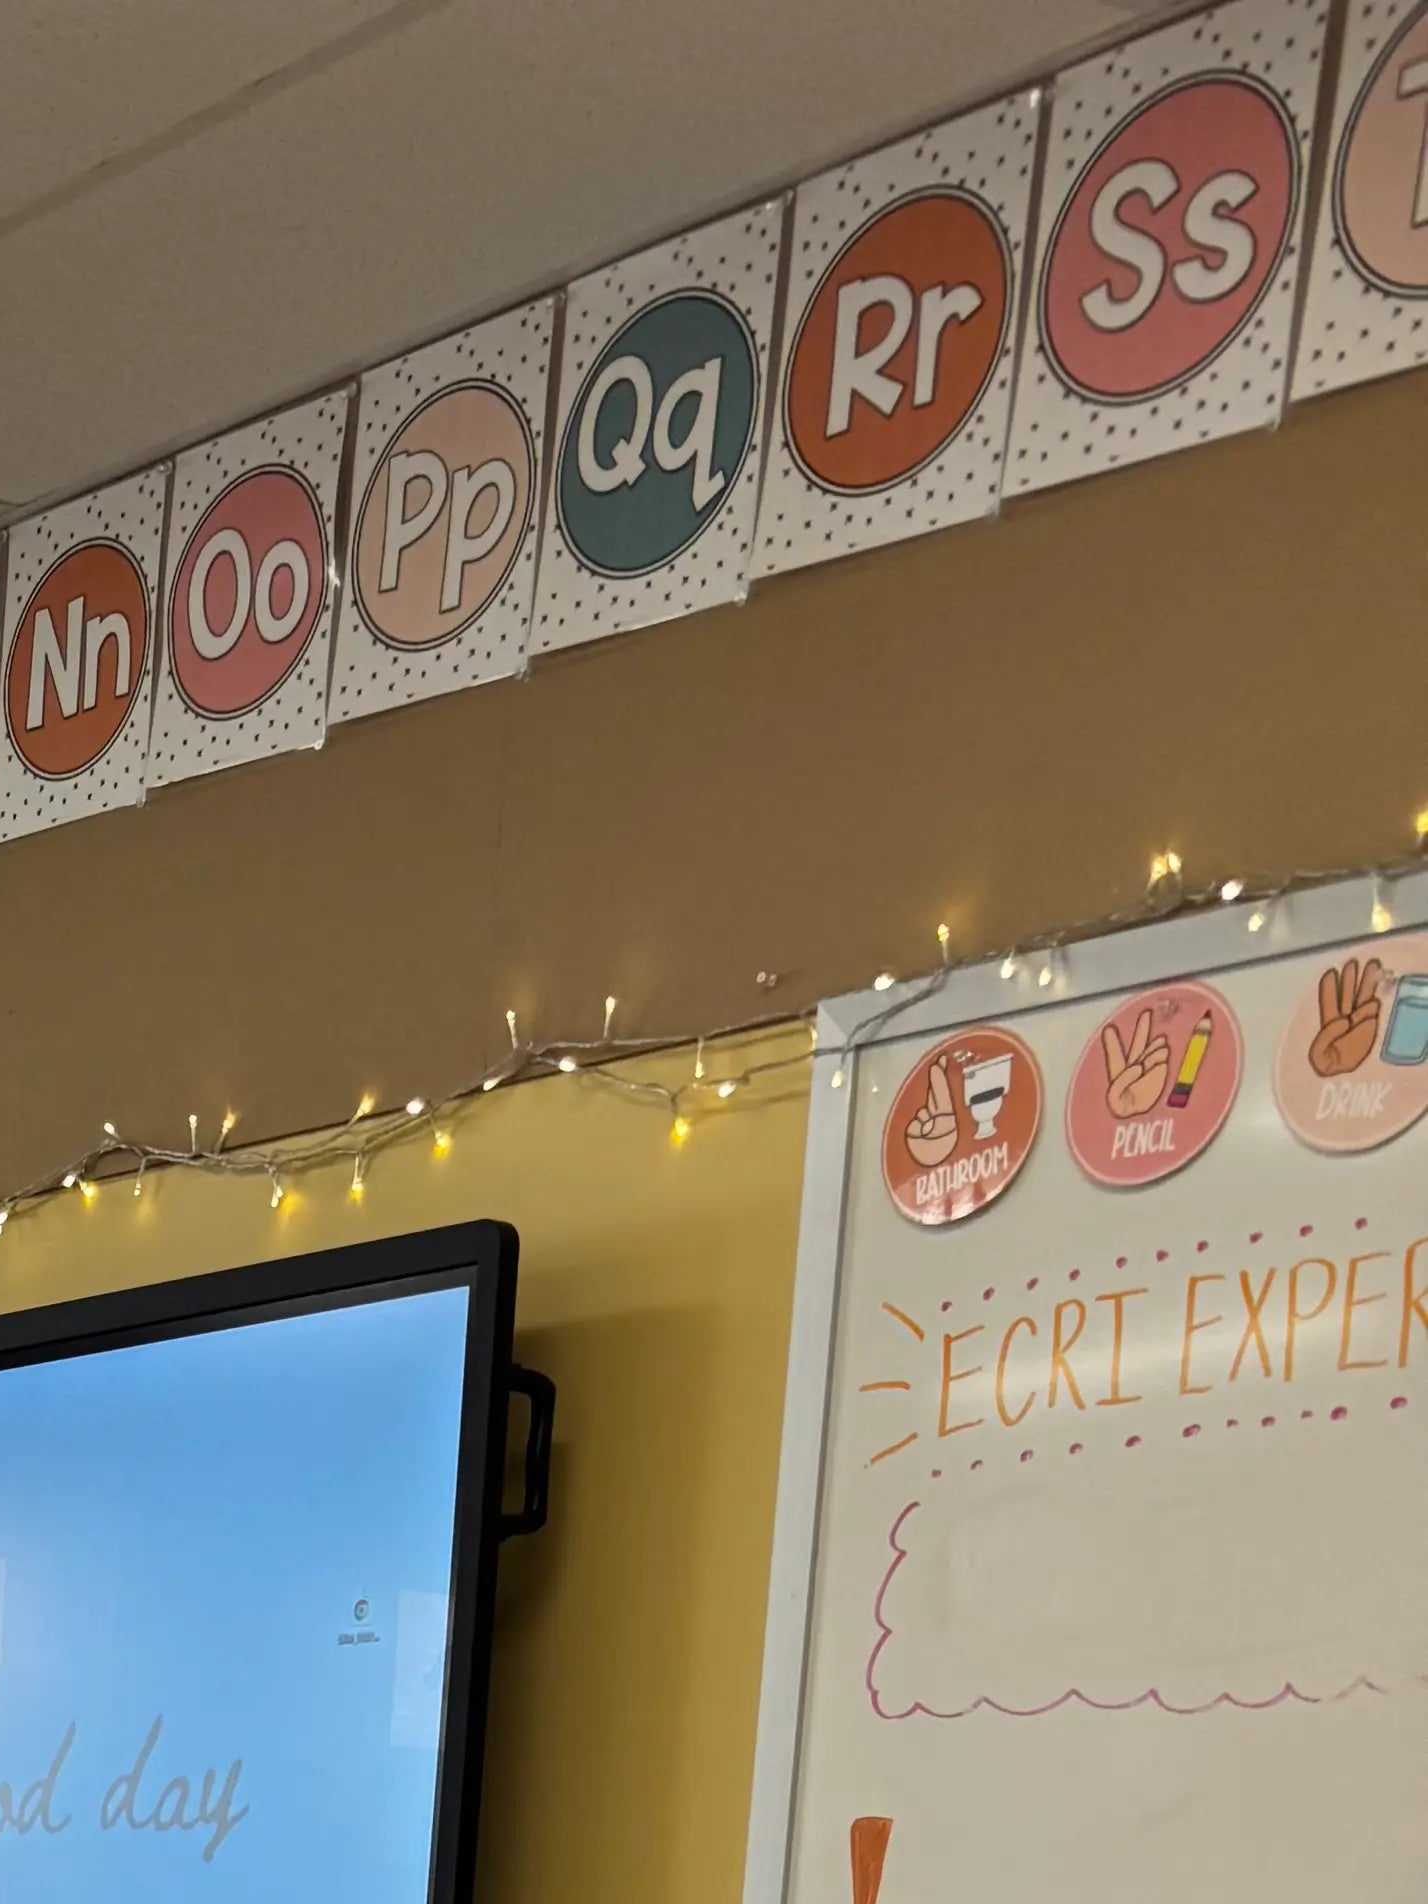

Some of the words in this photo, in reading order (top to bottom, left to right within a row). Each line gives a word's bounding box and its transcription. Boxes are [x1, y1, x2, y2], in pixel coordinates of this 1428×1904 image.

[24, 598, 132, 733] Nn
[187, 527, 310, 662] Oo
[377, 449, 517, 616] Pp
[577, 354, 725, 517] Qq
[825, 273, 985, 440] Rr
[1078, 157, 1261, 333] Ss
[1111, 1121, 1176, 1159] PENCIL
[1316, 1081, 1392, 1122] DRINK
[915, 1142, 1010, 1205] BATHROOM
[937, 1286, 1152, 1437] ECRI
[100, 1713, 249, 1862] day
